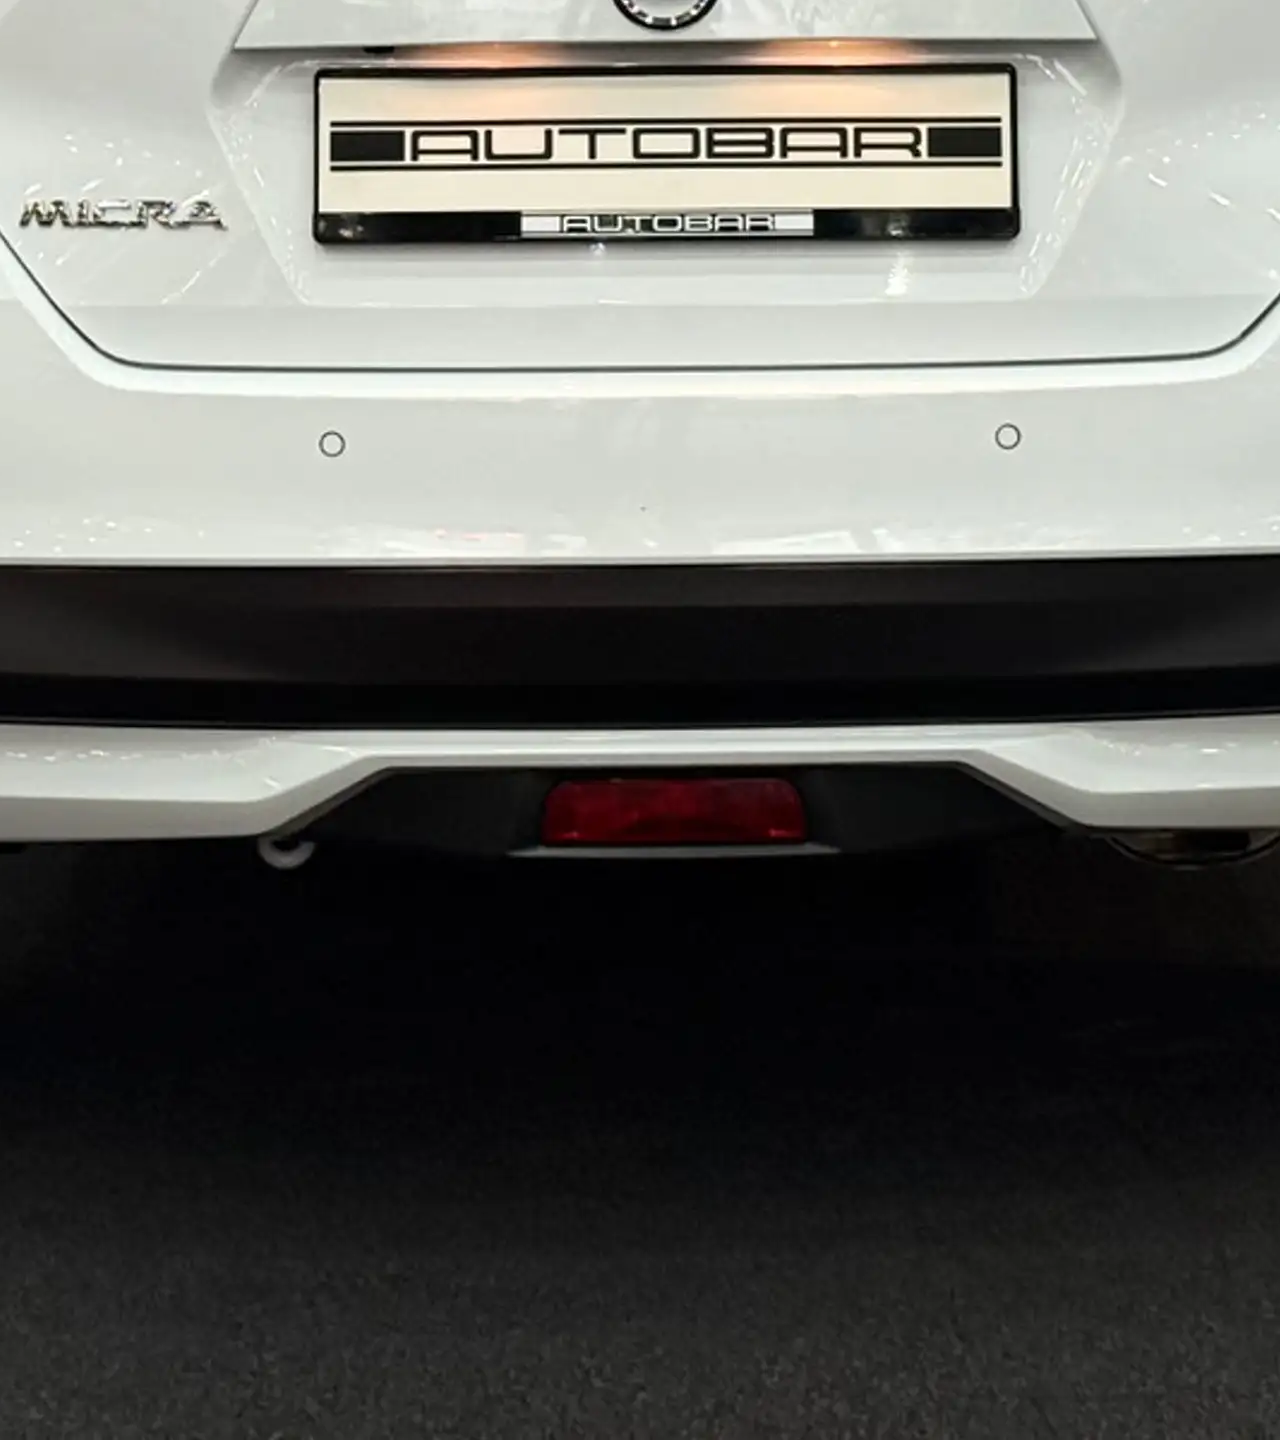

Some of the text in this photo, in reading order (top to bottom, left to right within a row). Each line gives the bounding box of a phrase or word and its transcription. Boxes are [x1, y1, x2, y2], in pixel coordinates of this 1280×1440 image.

[410, 127, 922, 161] AUTOBAR
[19, 200, 227, 231] MICRA
[561, 214, 775, 233] AUTOBAR
